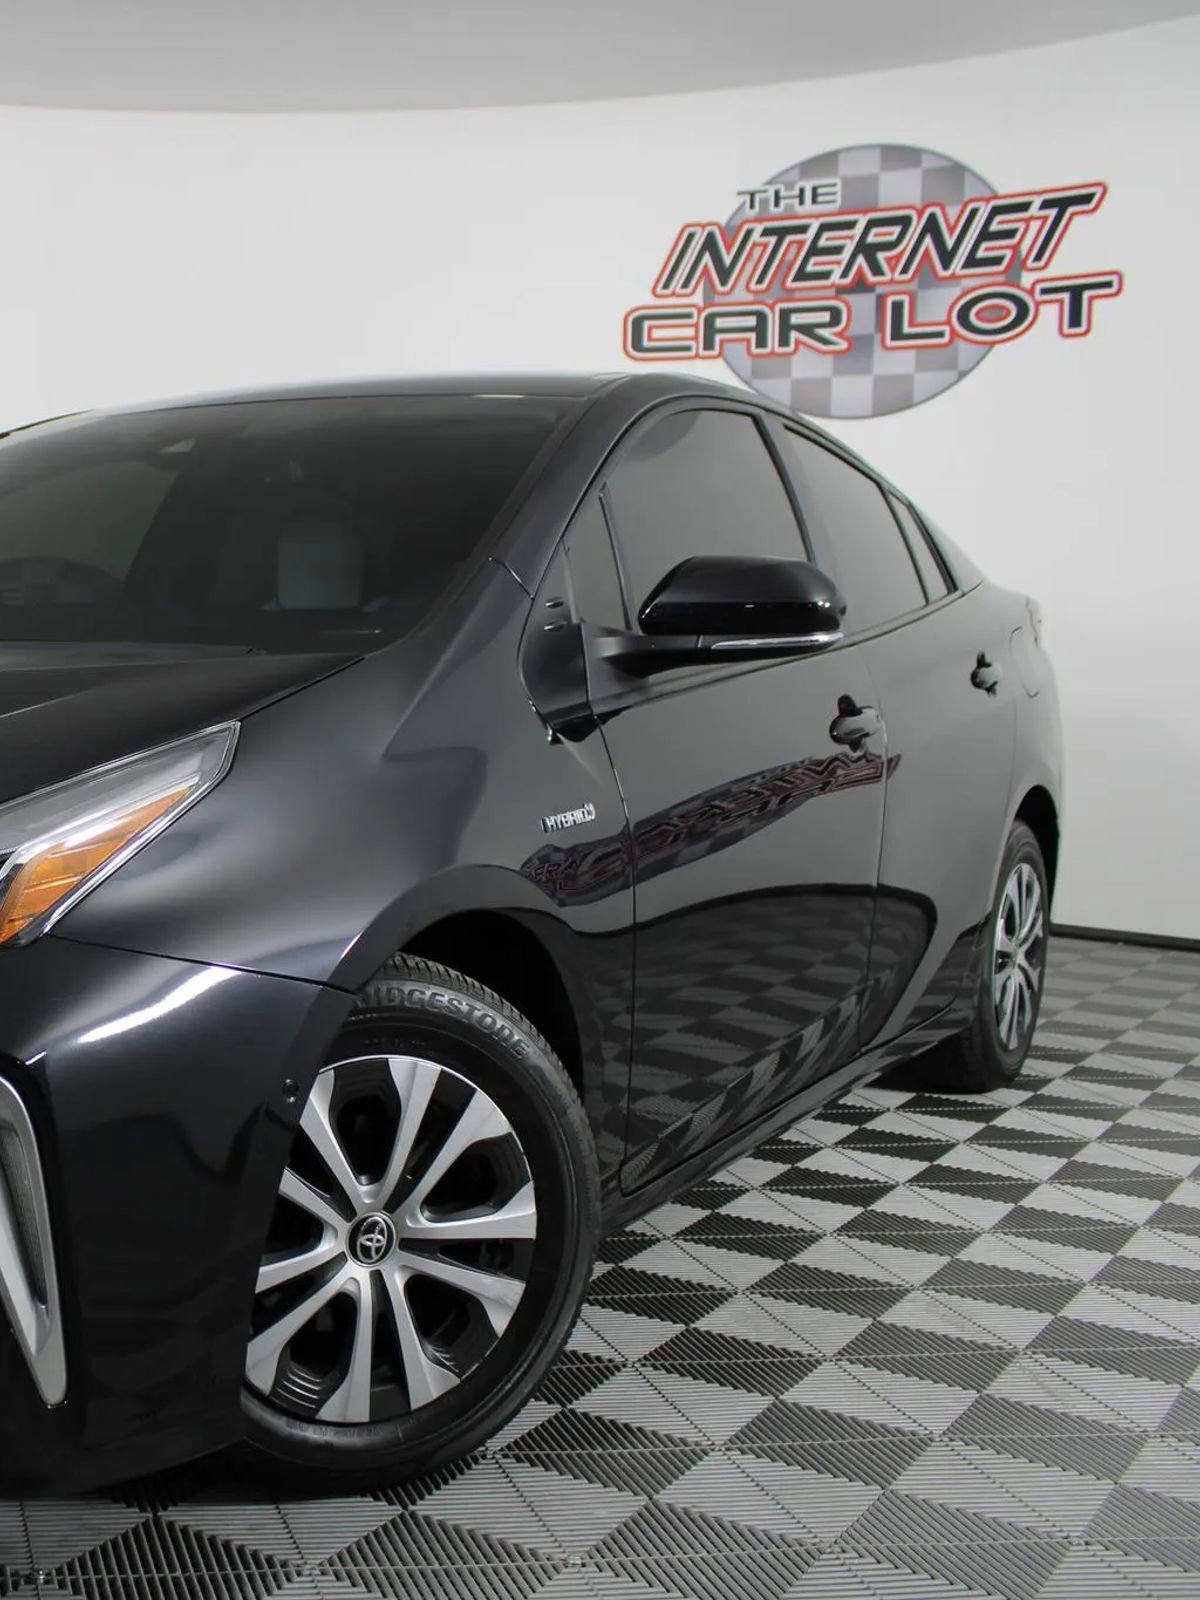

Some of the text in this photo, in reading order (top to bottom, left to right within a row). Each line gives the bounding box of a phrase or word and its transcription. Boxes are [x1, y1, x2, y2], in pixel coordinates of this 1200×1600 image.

[735, 181, 840, 211] THE
[656, 186, 1104, 294] INTERNET
[626, 275, 1120, 358] CAR LOT
[543, 808, 592, 831] HYBRID
